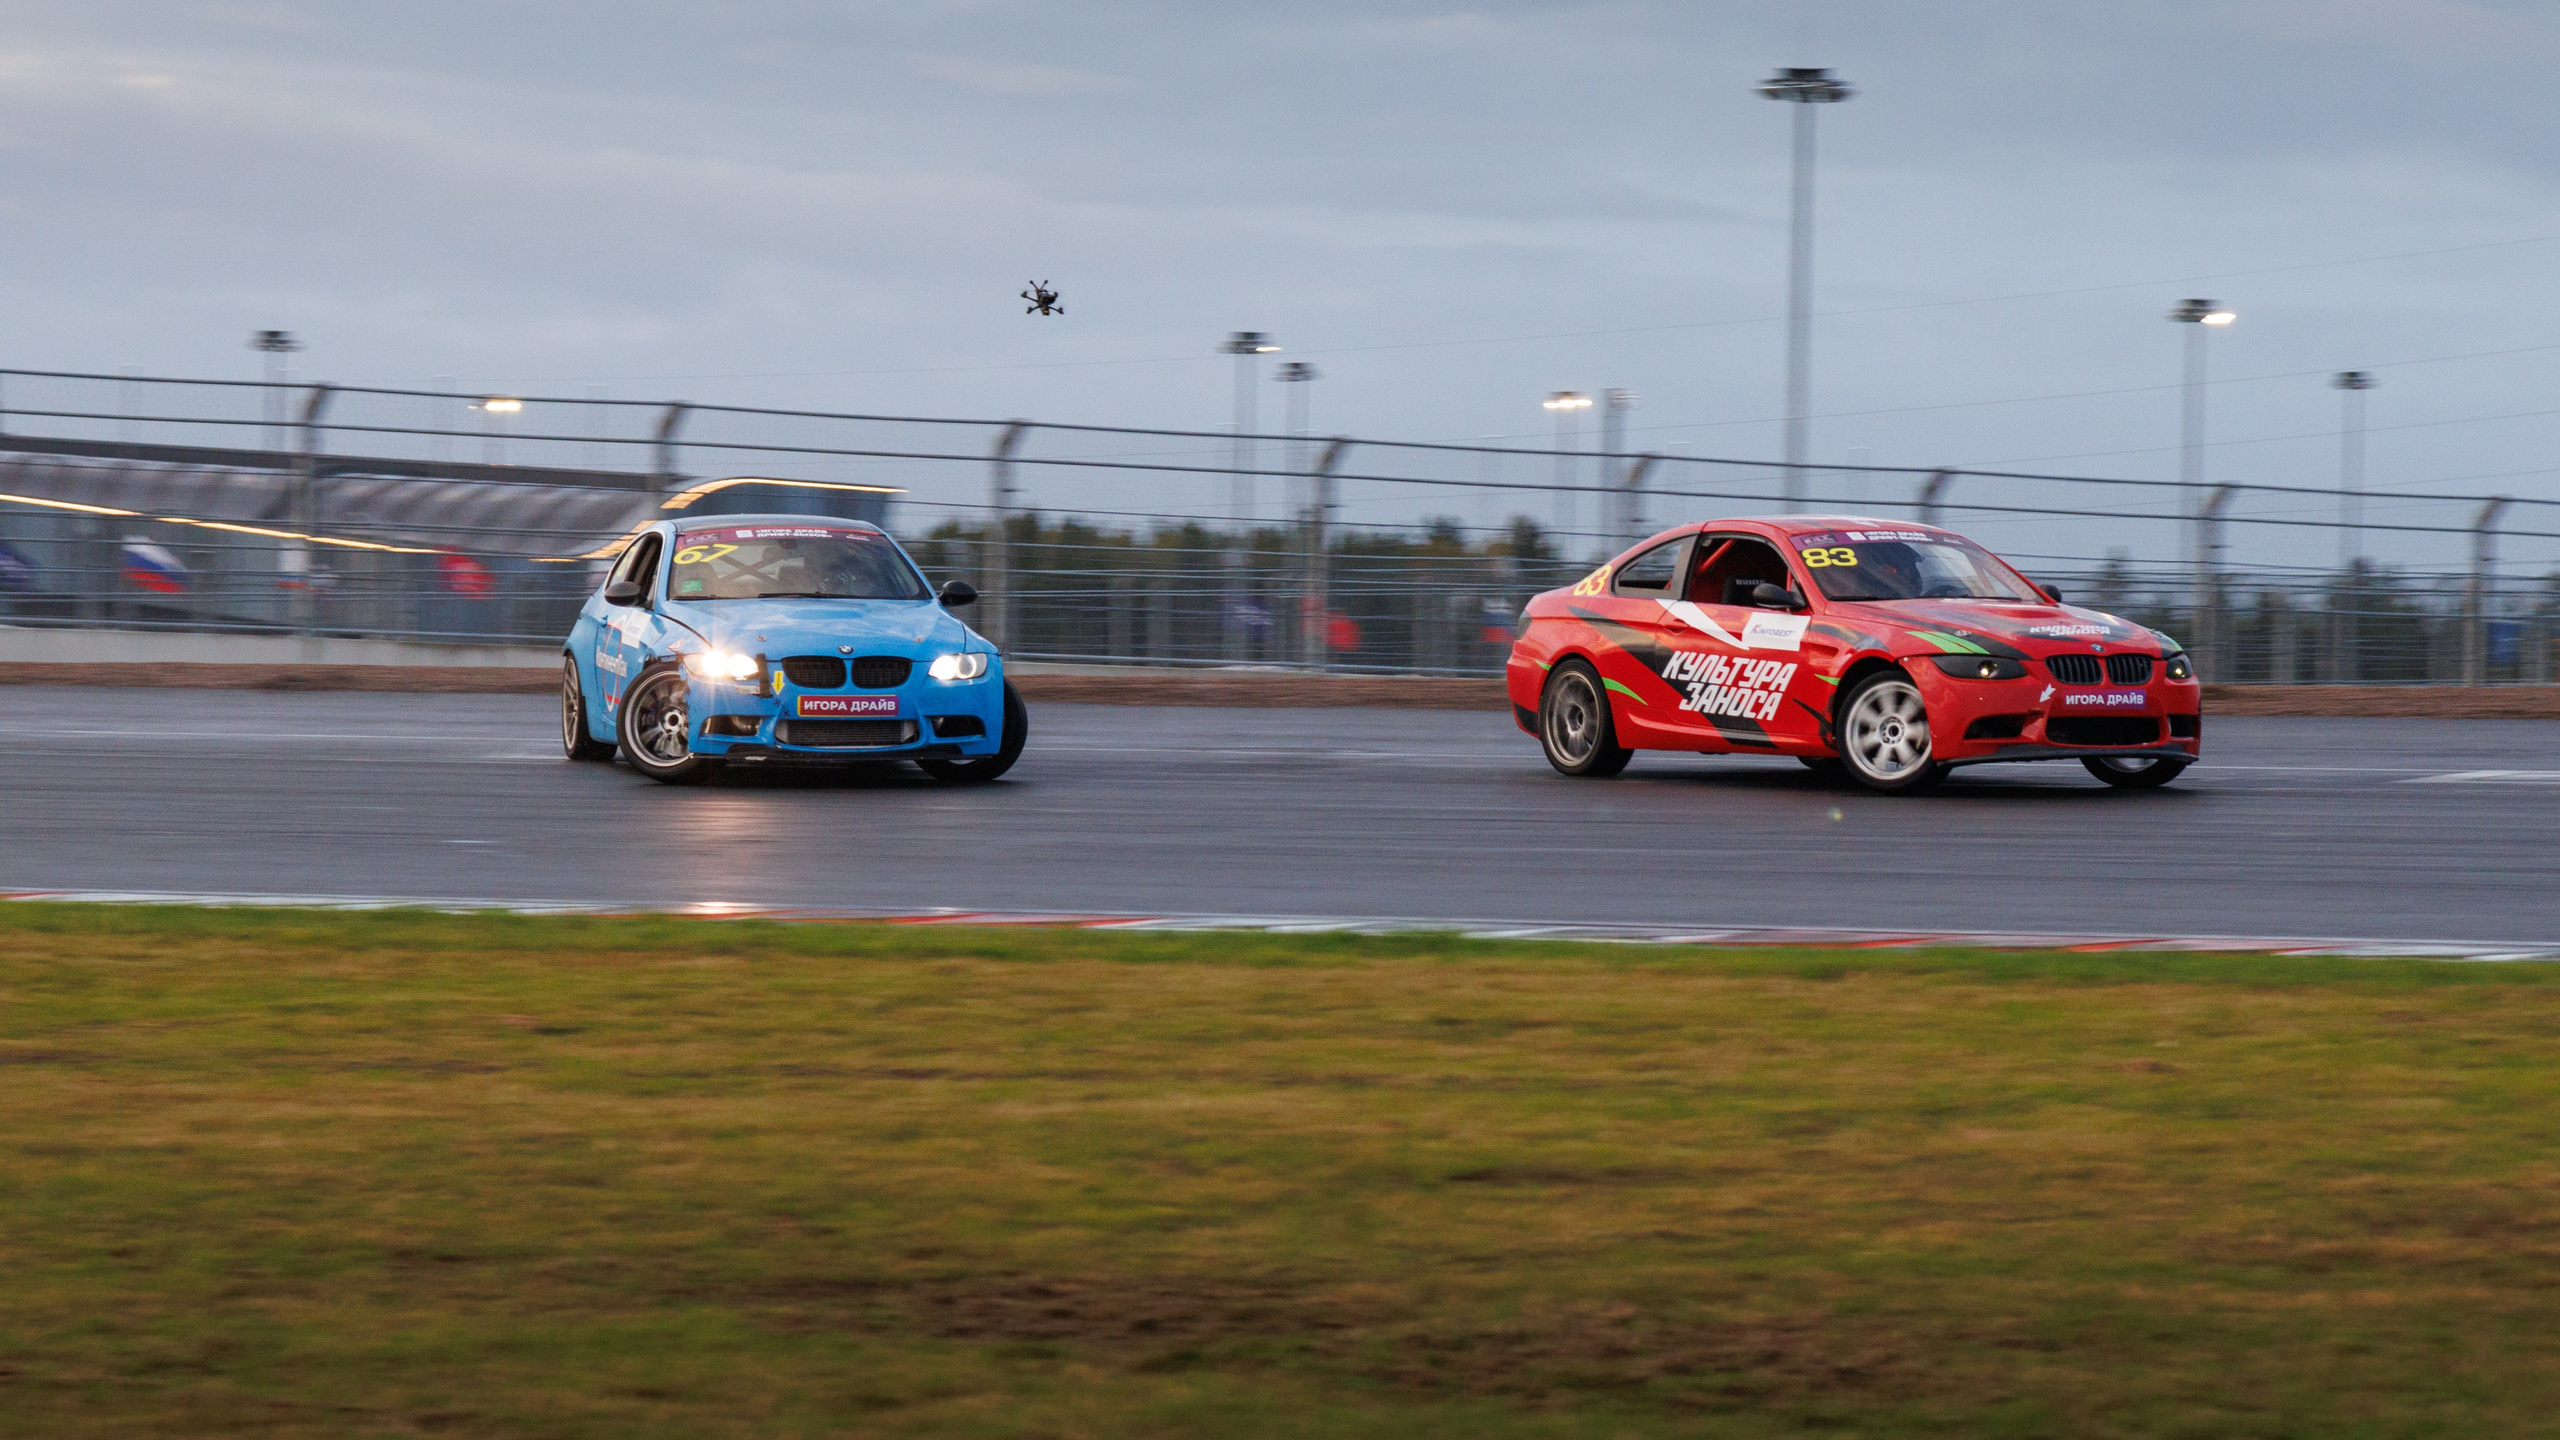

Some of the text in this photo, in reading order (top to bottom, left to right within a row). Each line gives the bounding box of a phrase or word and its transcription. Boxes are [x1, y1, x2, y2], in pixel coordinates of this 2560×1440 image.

[673, 543, 739, 565] 67
[1801, 548, 1858, 567] 83
[1662, 650, 1798, 692] КУЛЬТУРА
[804, 699, 896, 711] ИГОРА ДРАЙВ
[1678, 682, 1783, 721] ЗАНОСА
[2065, 692, 2144, 705] ИГОРА ДРАЙВ
